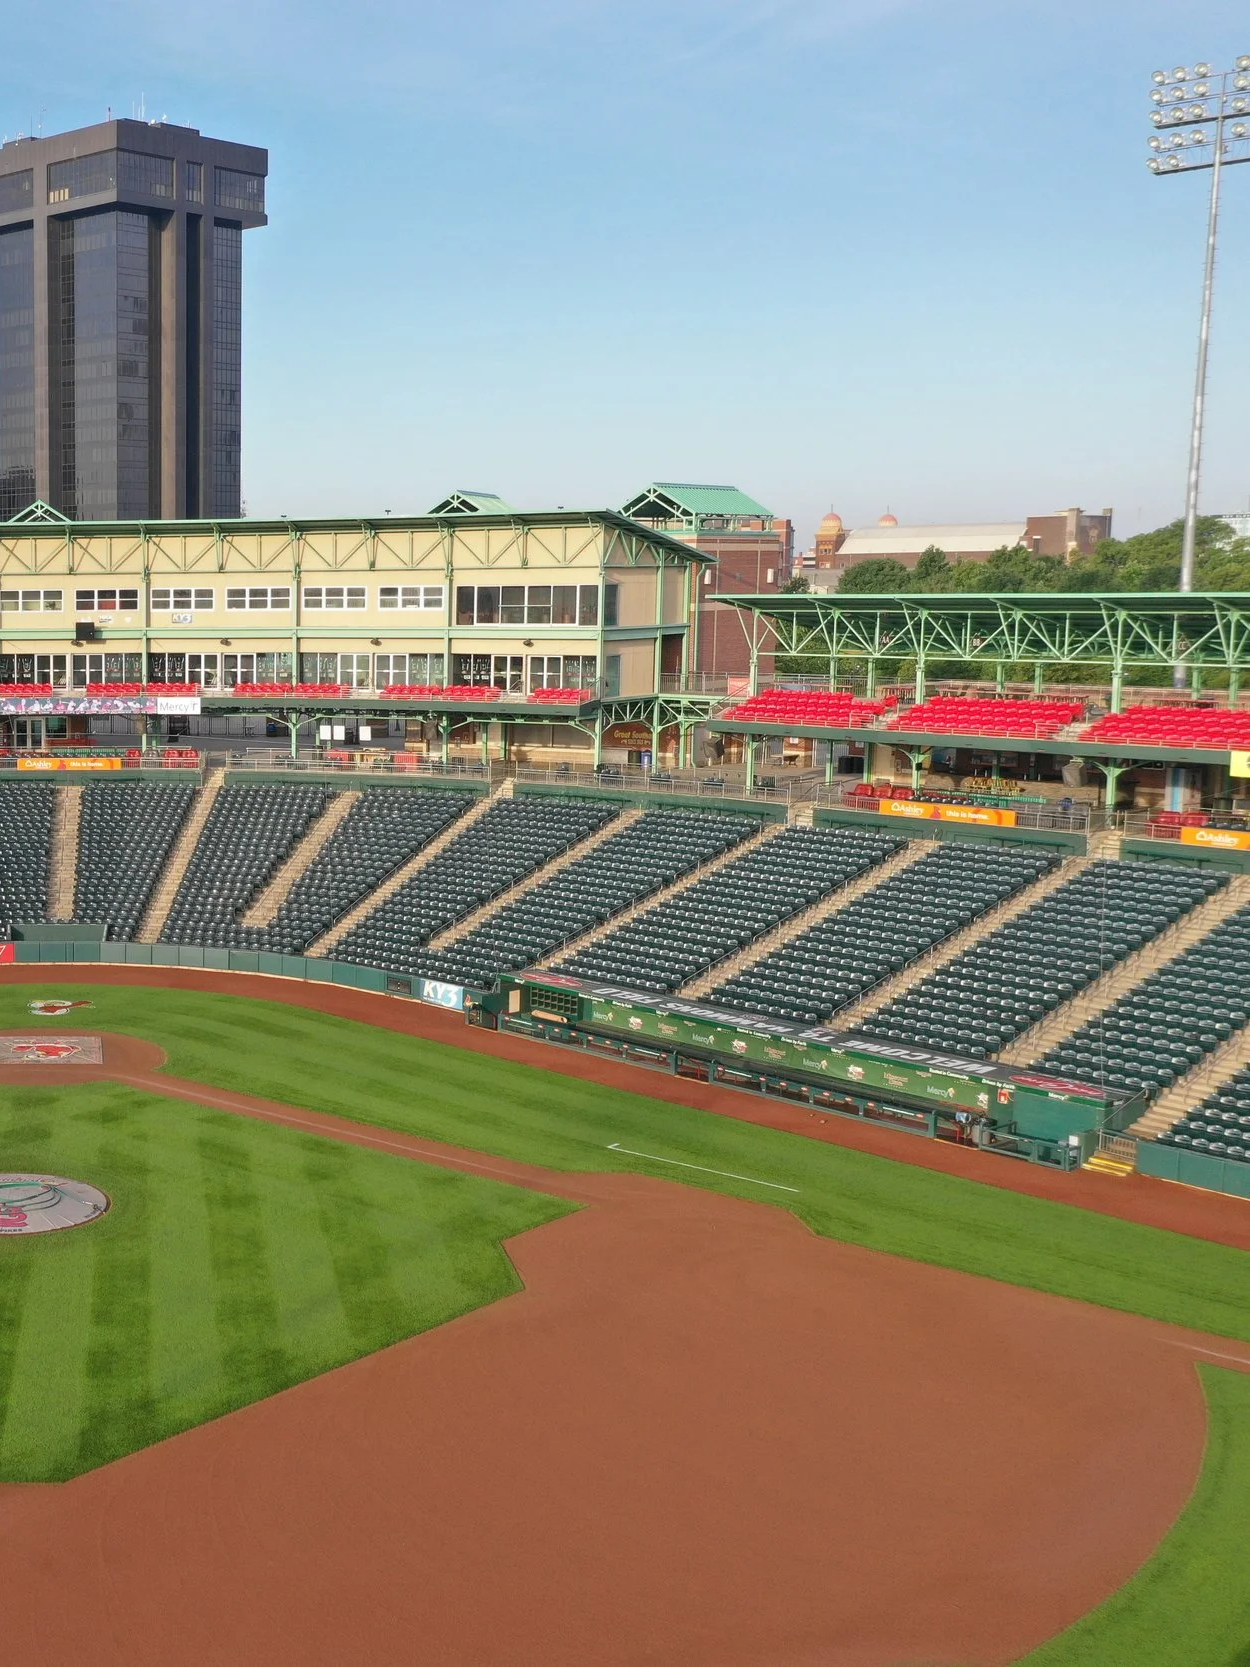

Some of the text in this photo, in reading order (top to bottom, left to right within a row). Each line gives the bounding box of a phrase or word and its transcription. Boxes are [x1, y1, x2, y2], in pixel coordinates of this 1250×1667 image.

[159, 702, 189, 714] Mercy
[32, 760, 52, 768] Ashley
[899, 804, 924, 815] Ashley
[946, 810, 960, 818] this
[423, 980, 458, 1007] KY3
[692, 1033, 710, 1045] Mercy
[838, 1040, 997, 1074] WELCOME
[803, 1059, 822, 1070] Mercy
[927, 1085, 949, 1098] Mercy
[1048, 1091, 1066, 1101] Mercy
